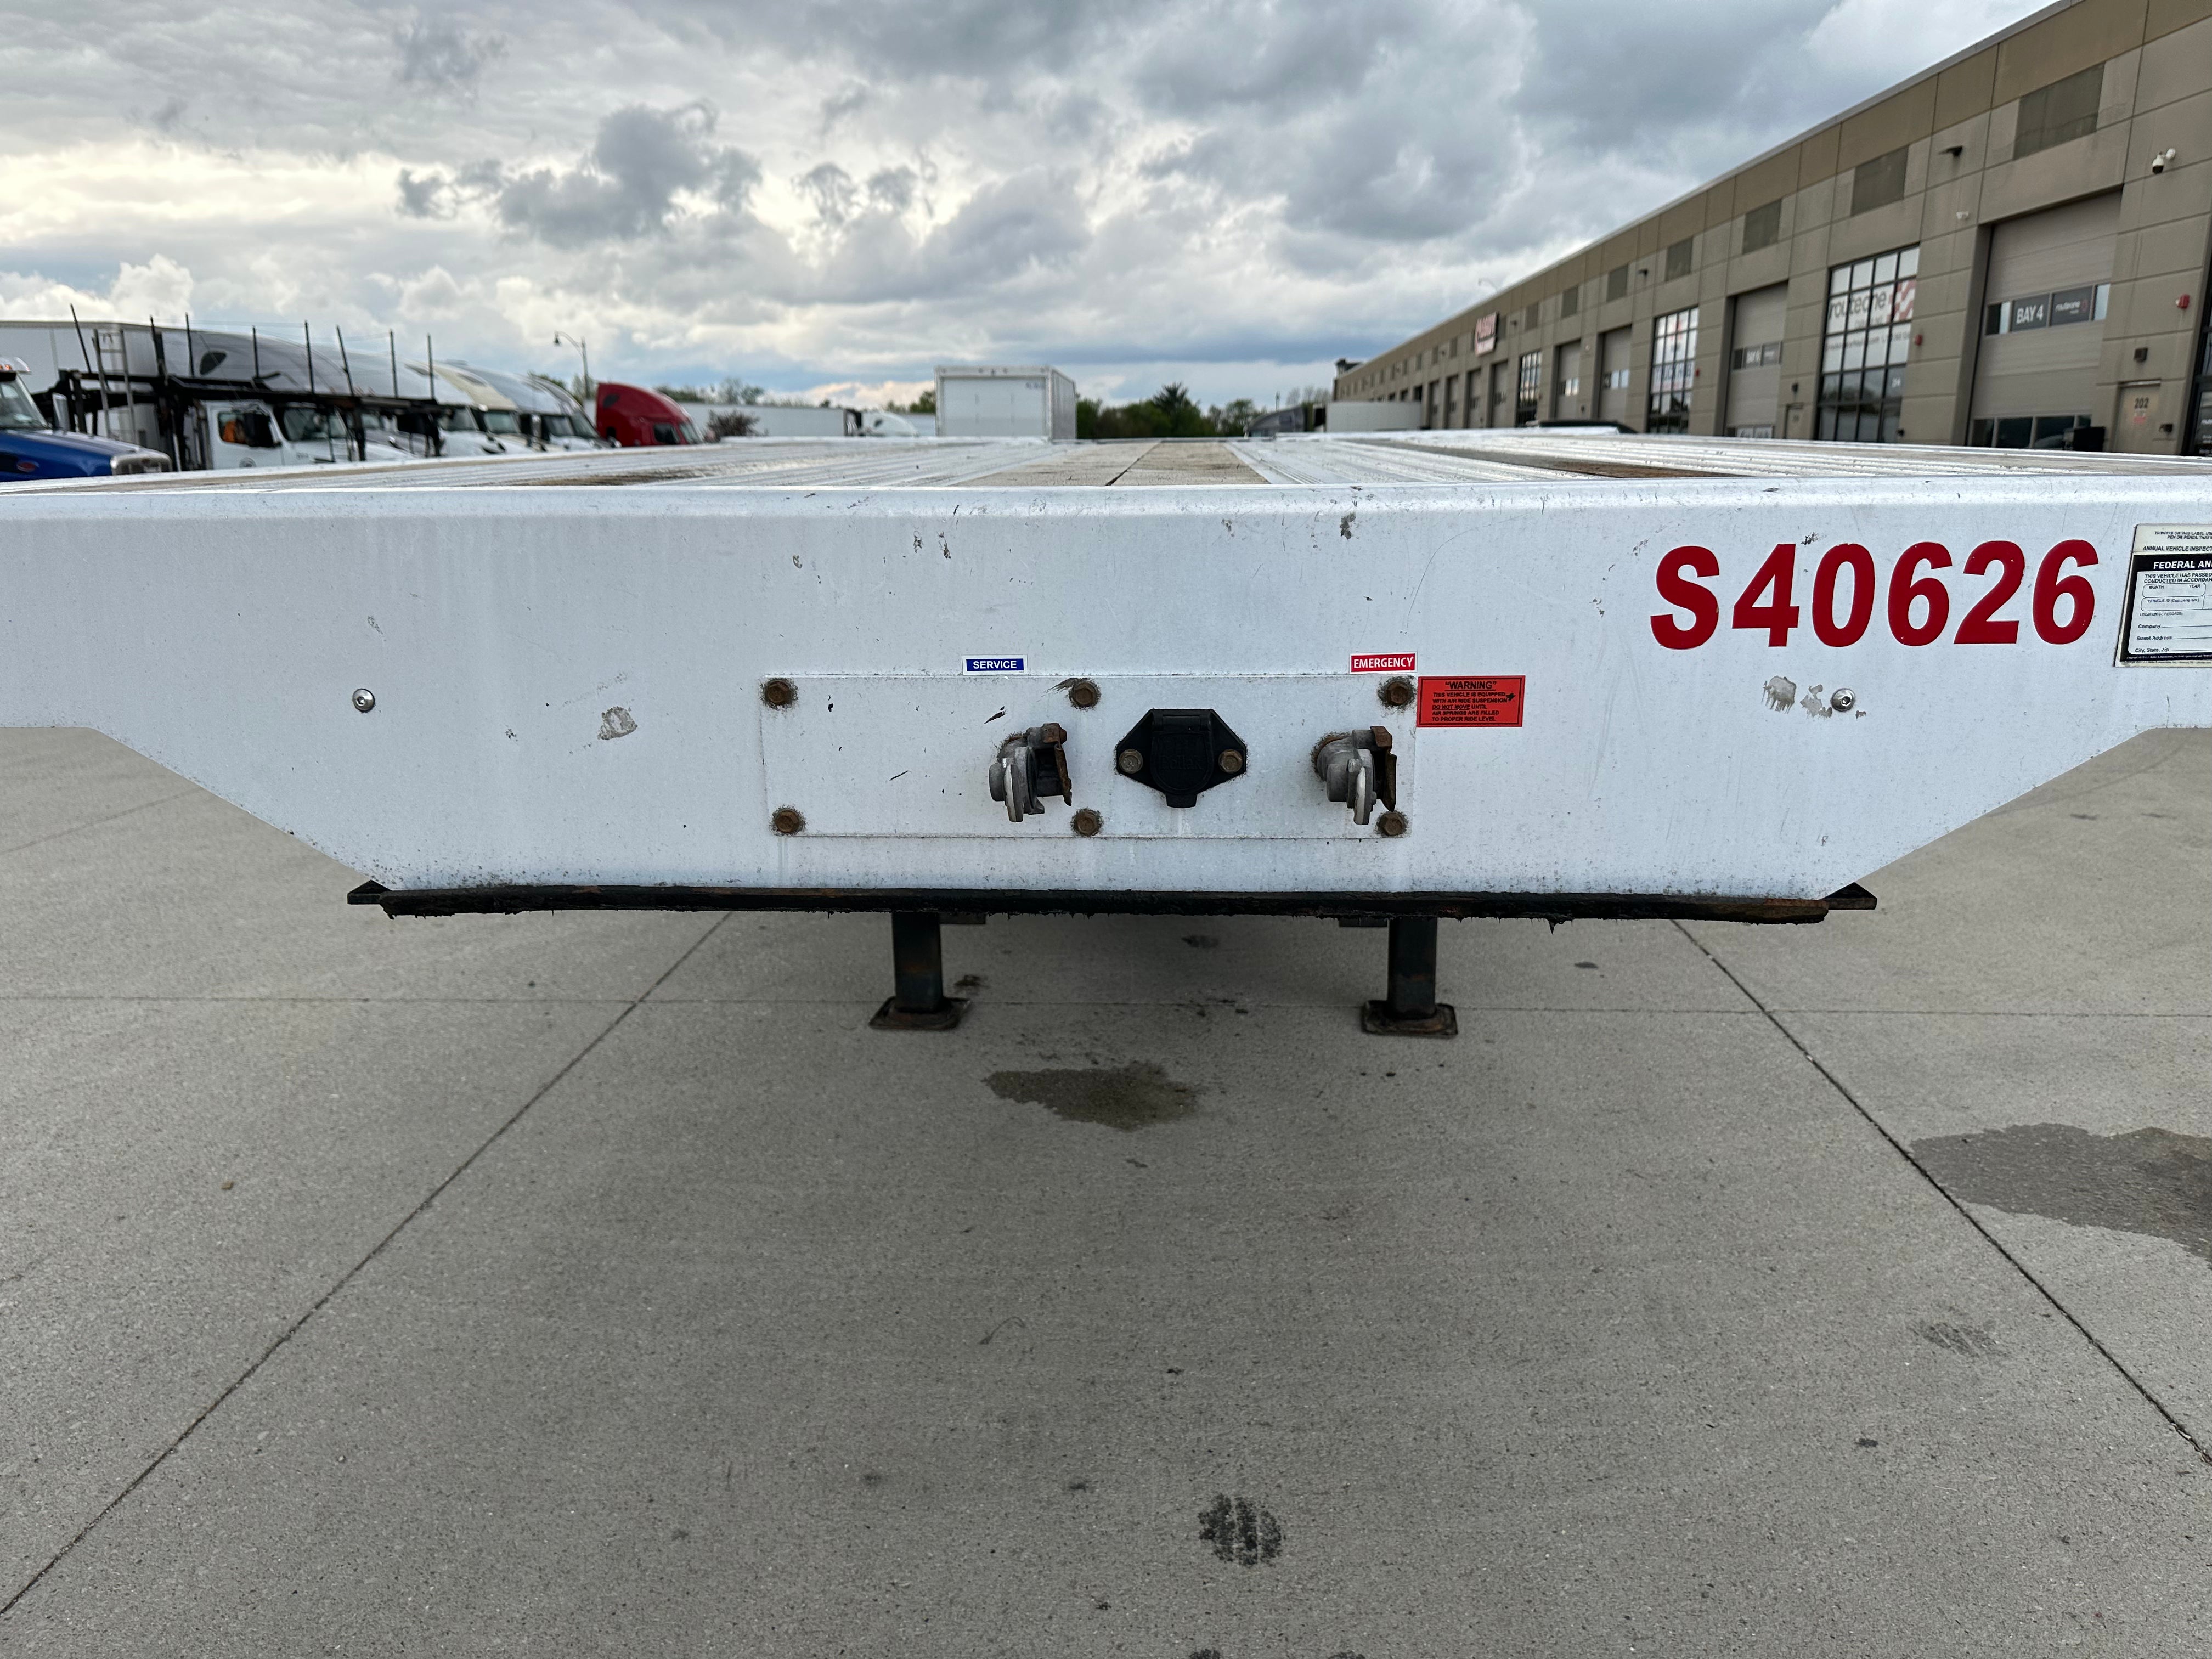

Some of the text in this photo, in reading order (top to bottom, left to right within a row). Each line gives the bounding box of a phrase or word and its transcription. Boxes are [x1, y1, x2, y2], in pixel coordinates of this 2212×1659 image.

[2016, 304, 2044, 324] BAY 4
[2135, 397, 2149, 409] 202
[2153, 560, 2212, 569] FEDERAL AN
[1650, 539, 2098, 650] S40626
[973, 661, 1017, 669] SERVICE
[1353, 657, 1414, 669] EMERGENCY
